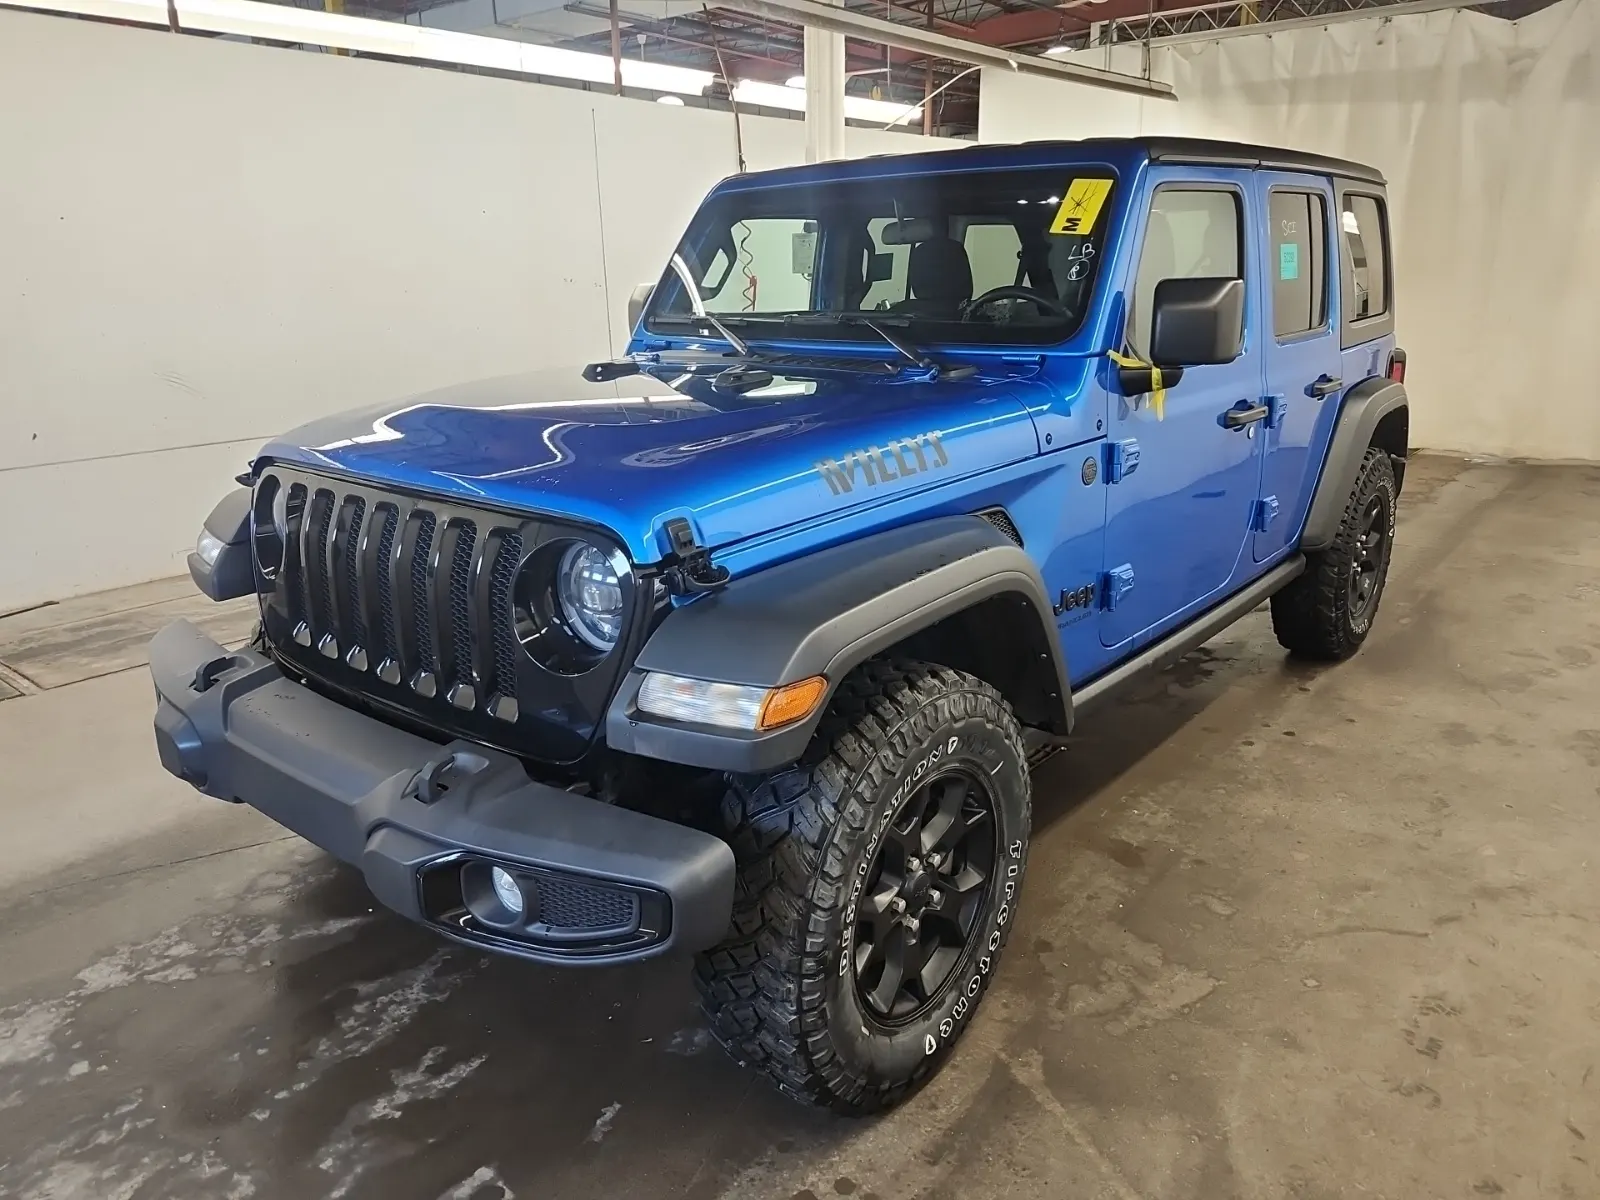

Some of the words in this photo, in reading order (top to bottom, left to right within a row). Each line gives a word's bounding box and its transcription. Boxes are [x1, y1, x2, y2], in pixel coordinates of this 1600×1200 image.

[815, 430, 948, 495] WILLYS
[1053, 582, 1096, 616] Jeep
[839, 744, 943, 976] DESTINATION
